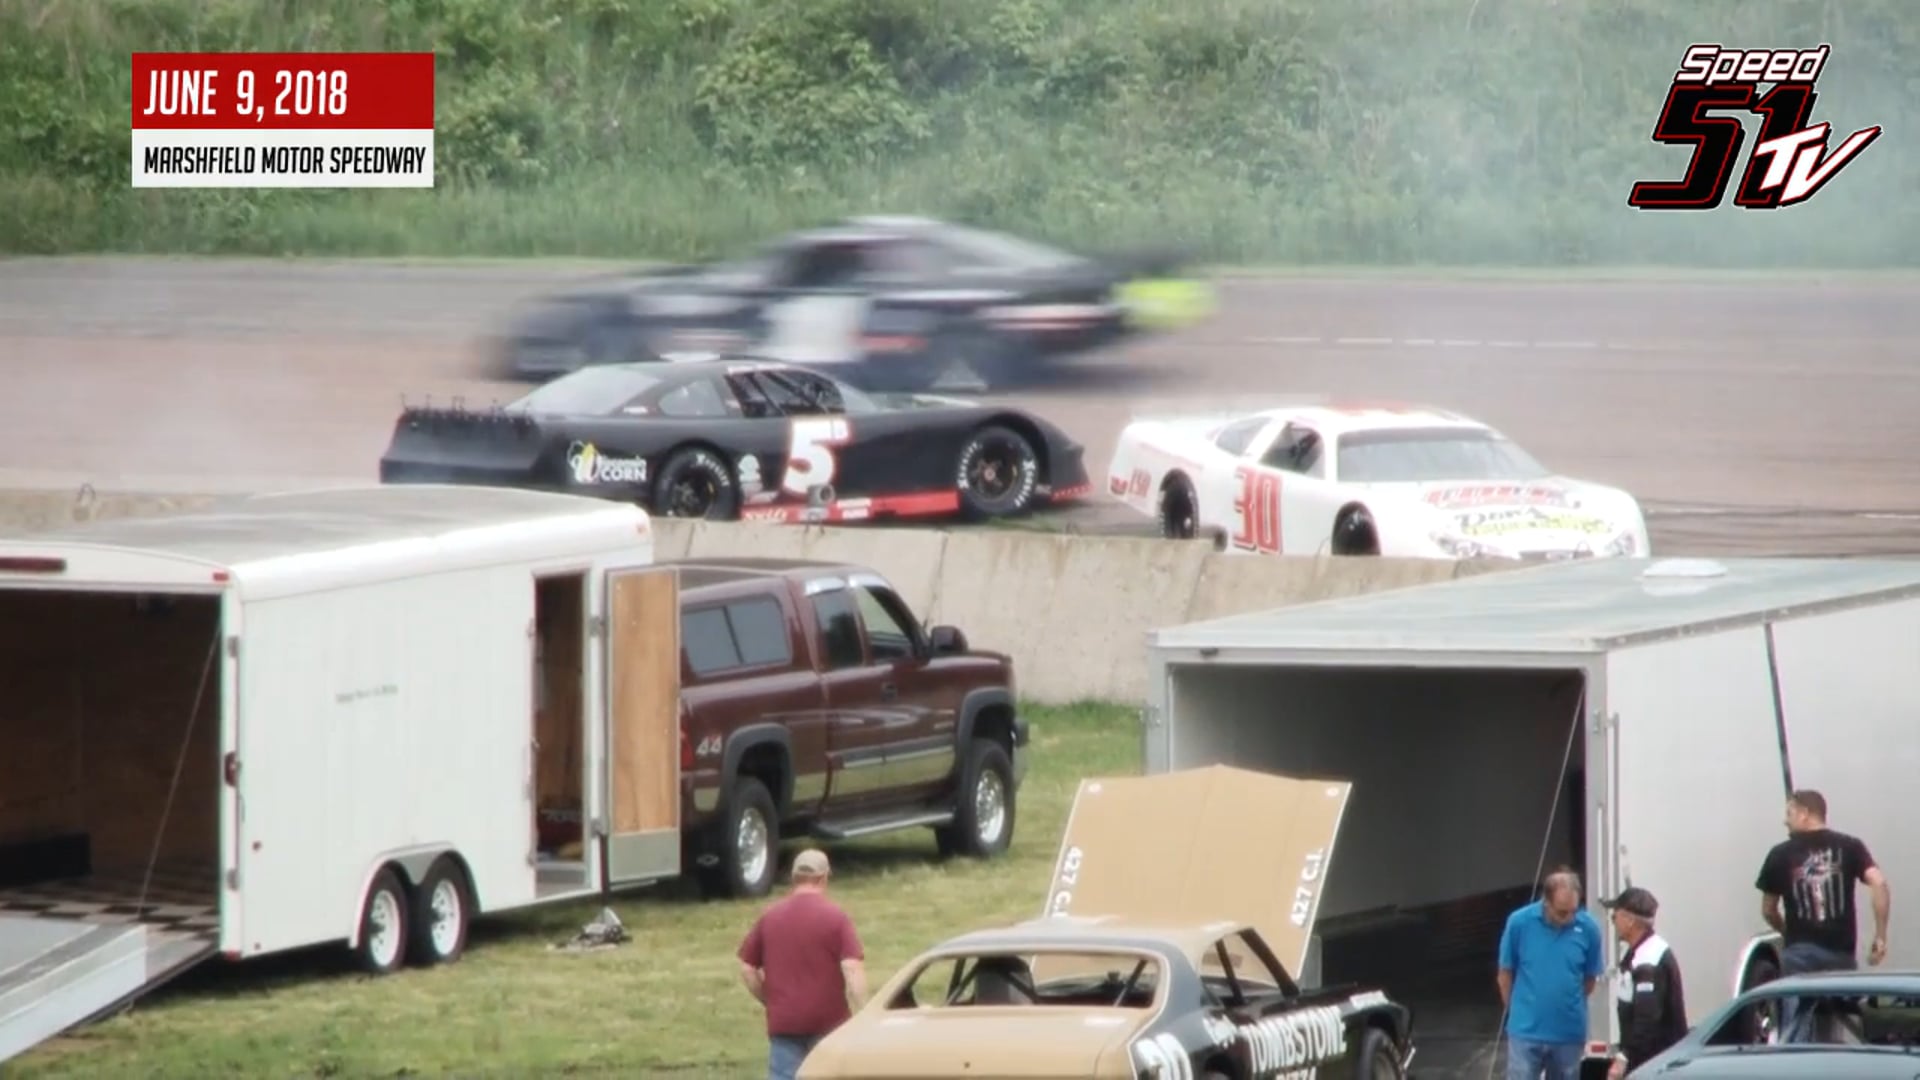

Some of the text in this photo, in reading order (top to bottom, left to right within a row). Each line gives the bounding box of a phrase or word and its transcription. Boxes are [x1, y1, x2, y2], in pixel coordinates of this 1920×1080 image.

[600, 466, 647, 482] CORN
[1233, 464, 1284, 555] 30
[1290, 887, 1313, 926] 427
[1240, 1004, 1348, 1073] TOMBSTONE
